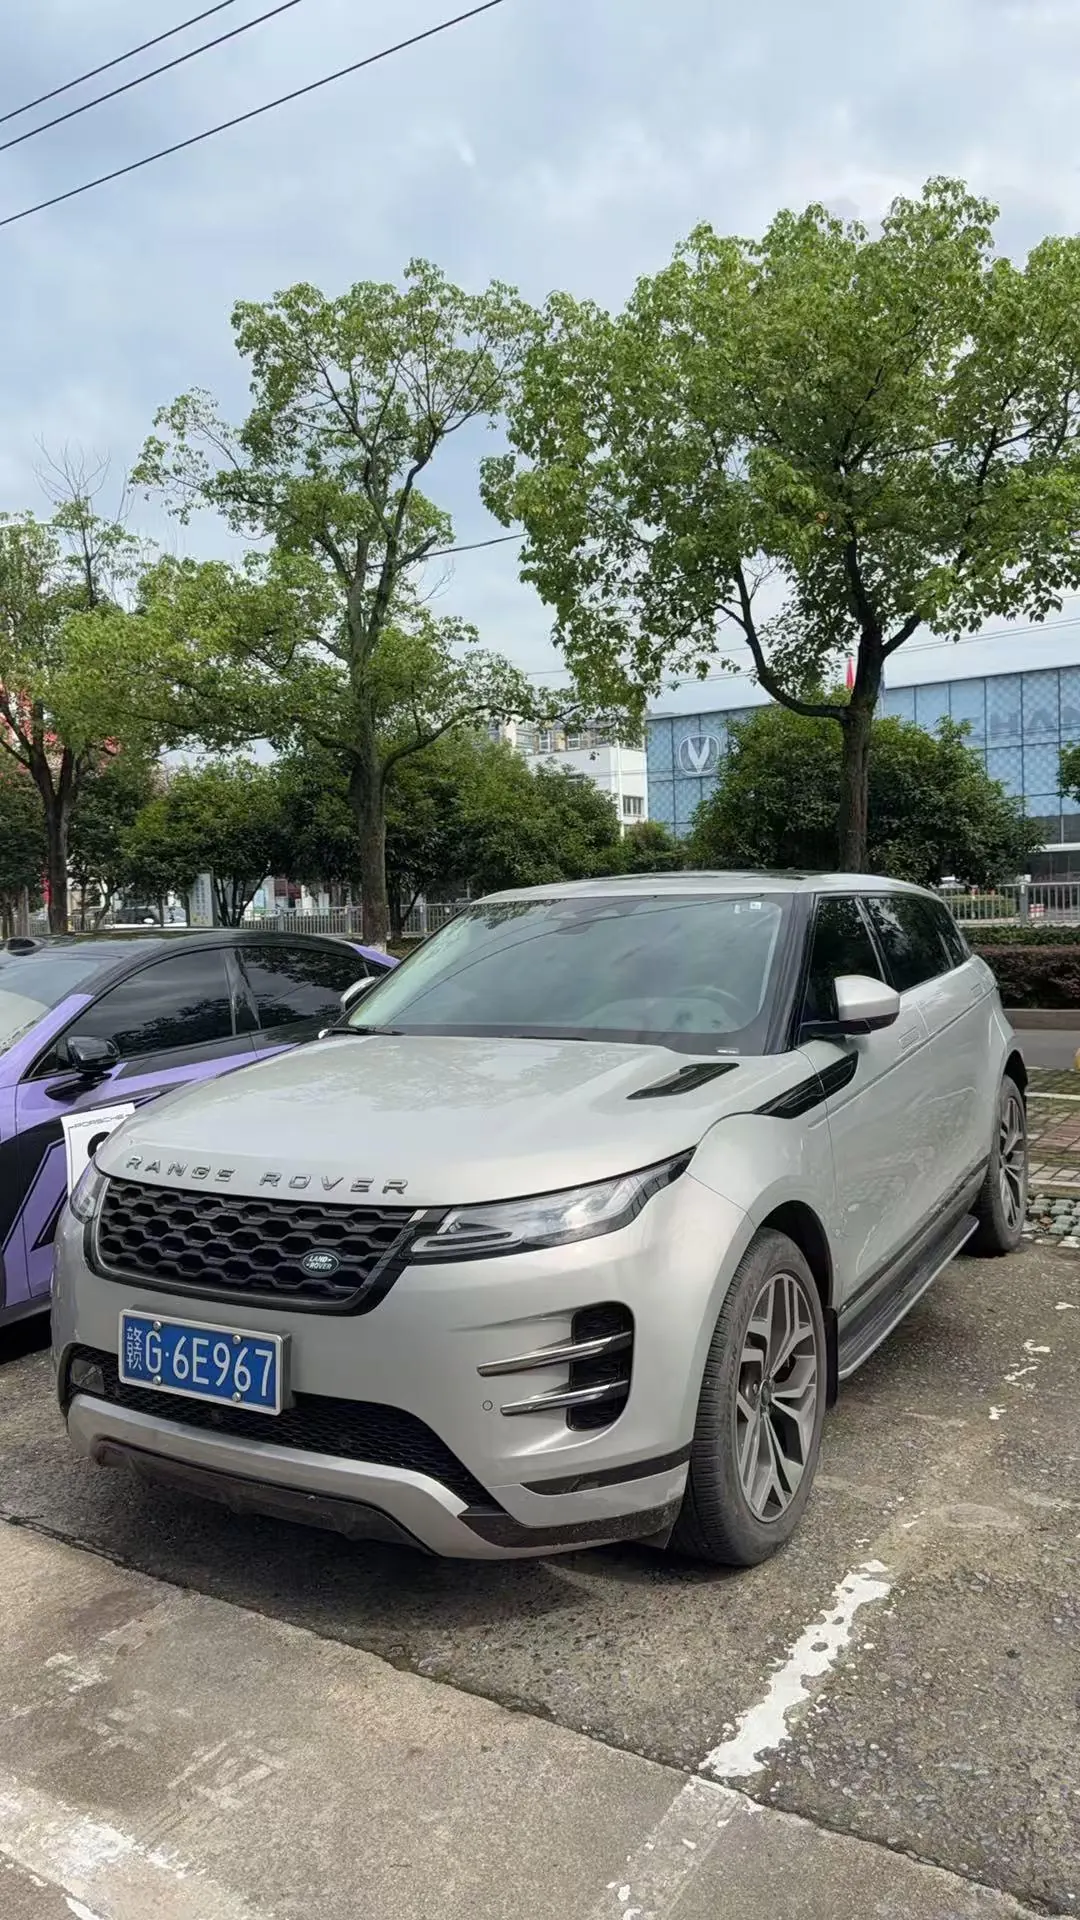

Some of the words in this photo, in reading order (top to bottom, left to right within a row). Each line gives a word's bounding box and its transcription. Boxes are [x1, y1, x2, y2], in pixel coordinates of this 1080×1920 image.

[126, 1155, 235, 1182] RANGE
[259, 1171, 408, 1195] ROVER
[309, 1255, 328, 1263] LAND
[309, 1262, 332, 1270] ROVER
